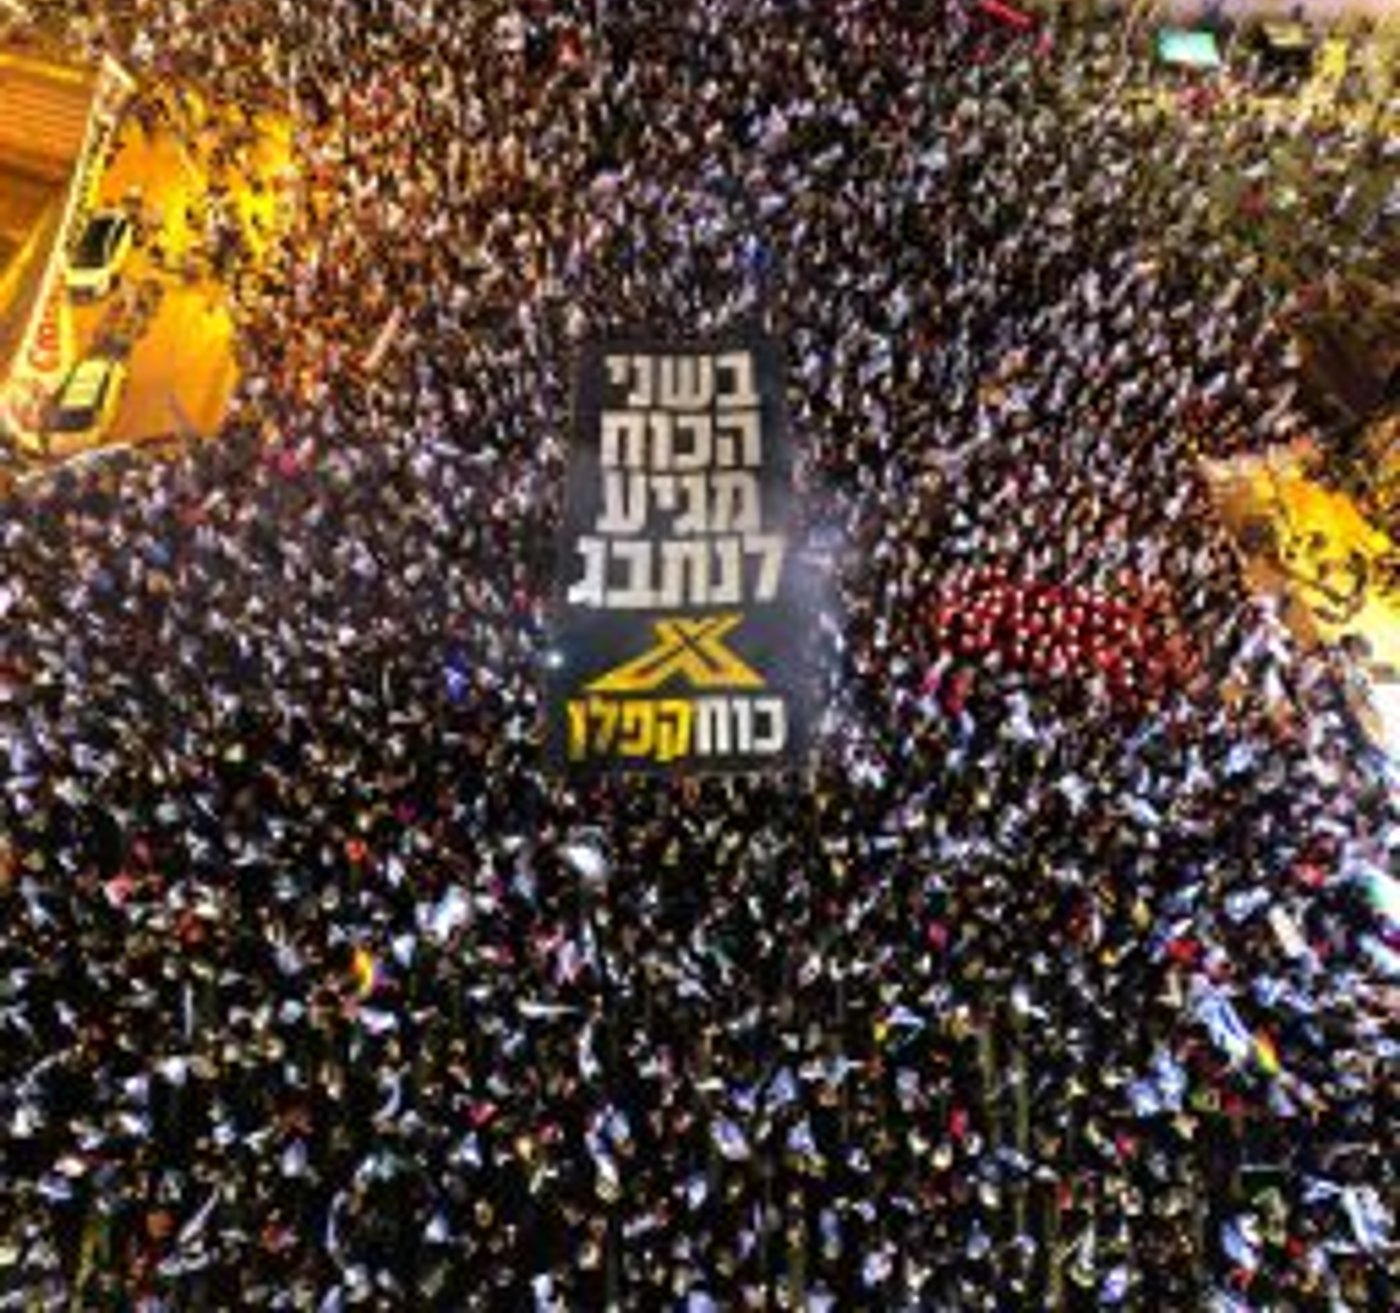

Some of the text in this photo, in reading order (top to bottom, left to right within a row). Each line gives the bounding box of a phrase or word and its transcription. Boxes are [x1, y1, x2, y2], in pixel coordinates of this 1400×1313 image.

[604, 351, 760, 408] בשני
[601, 410, 762, 468] הכוח
[595, 471, 762, 534] מגיע
[567, 534, 785, 608] לנתבג
